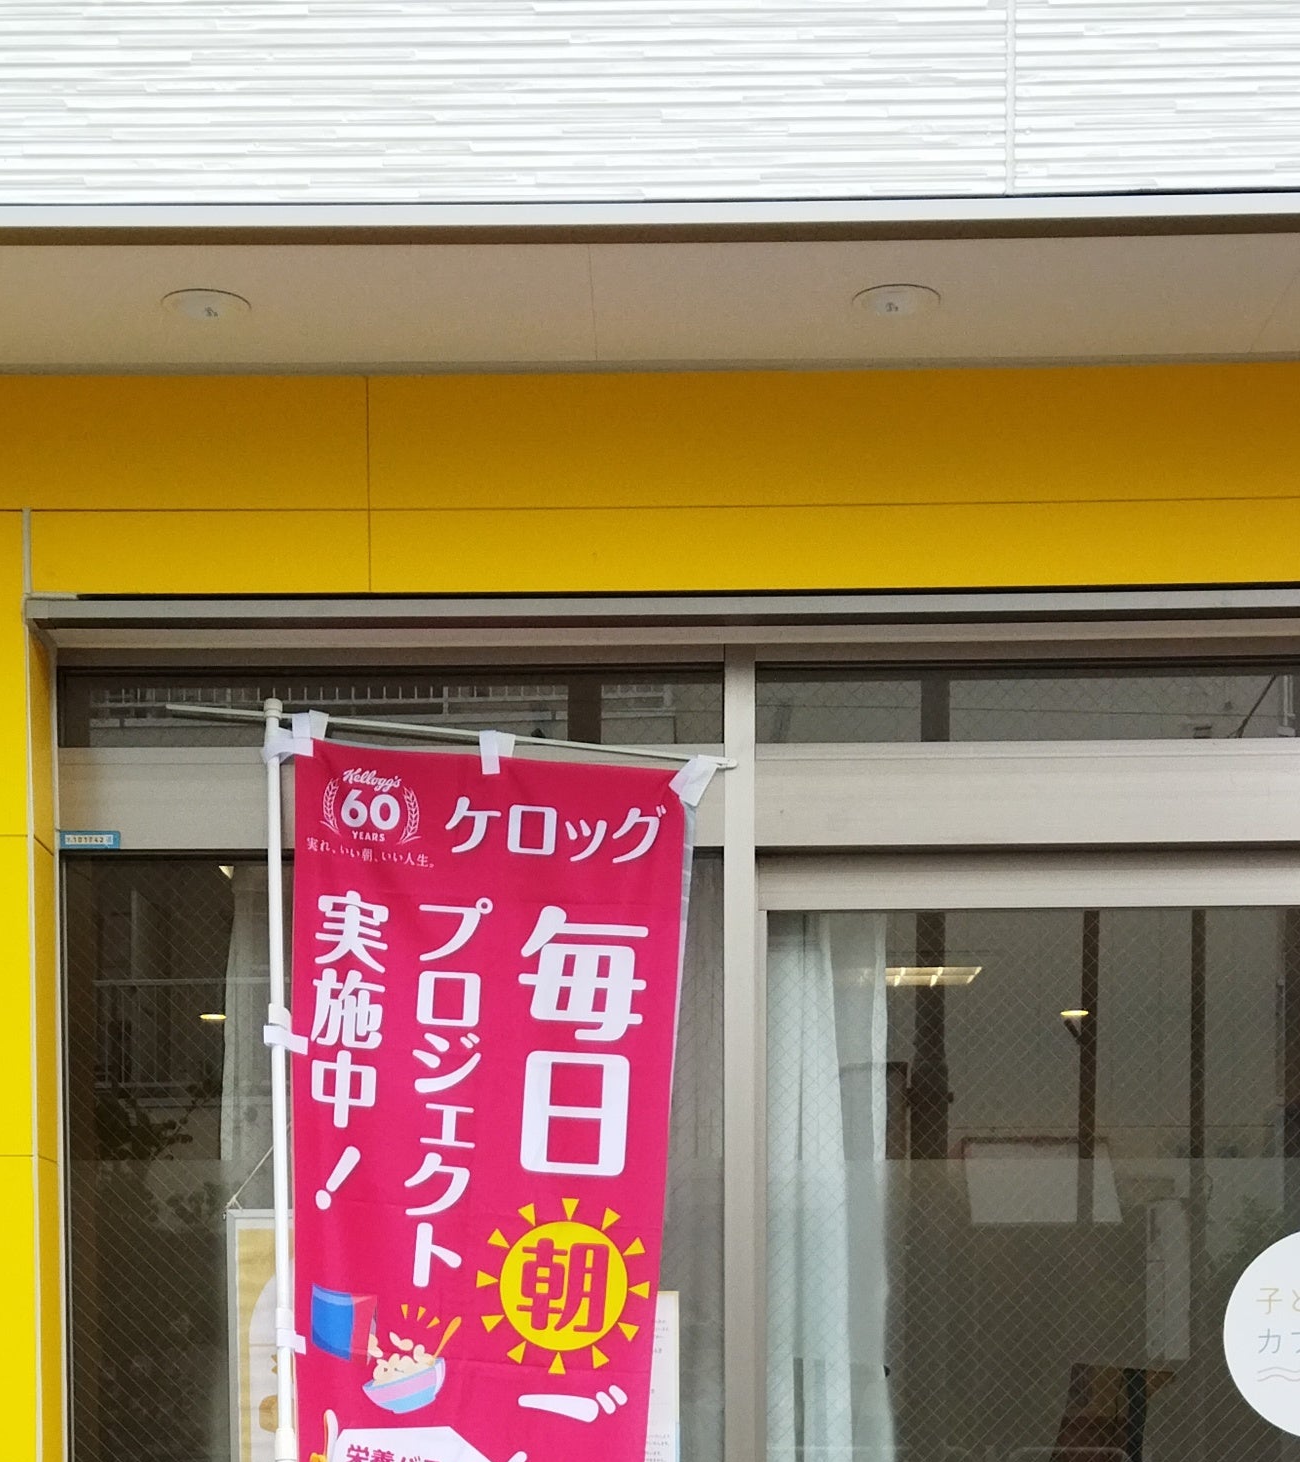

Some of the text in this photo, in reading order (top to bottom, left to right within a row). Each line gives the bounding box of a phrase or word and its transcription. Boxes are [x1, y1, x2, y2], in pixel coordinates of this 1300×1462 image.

[342, 767, 402, 792] Kellogg's
[341, 789, 401, 830] 60
[445, 795, 668, 864] ケロッグ
[351, 830, 386, 842] YEARS
[404, 896, 494, 1288] プロジェクト
